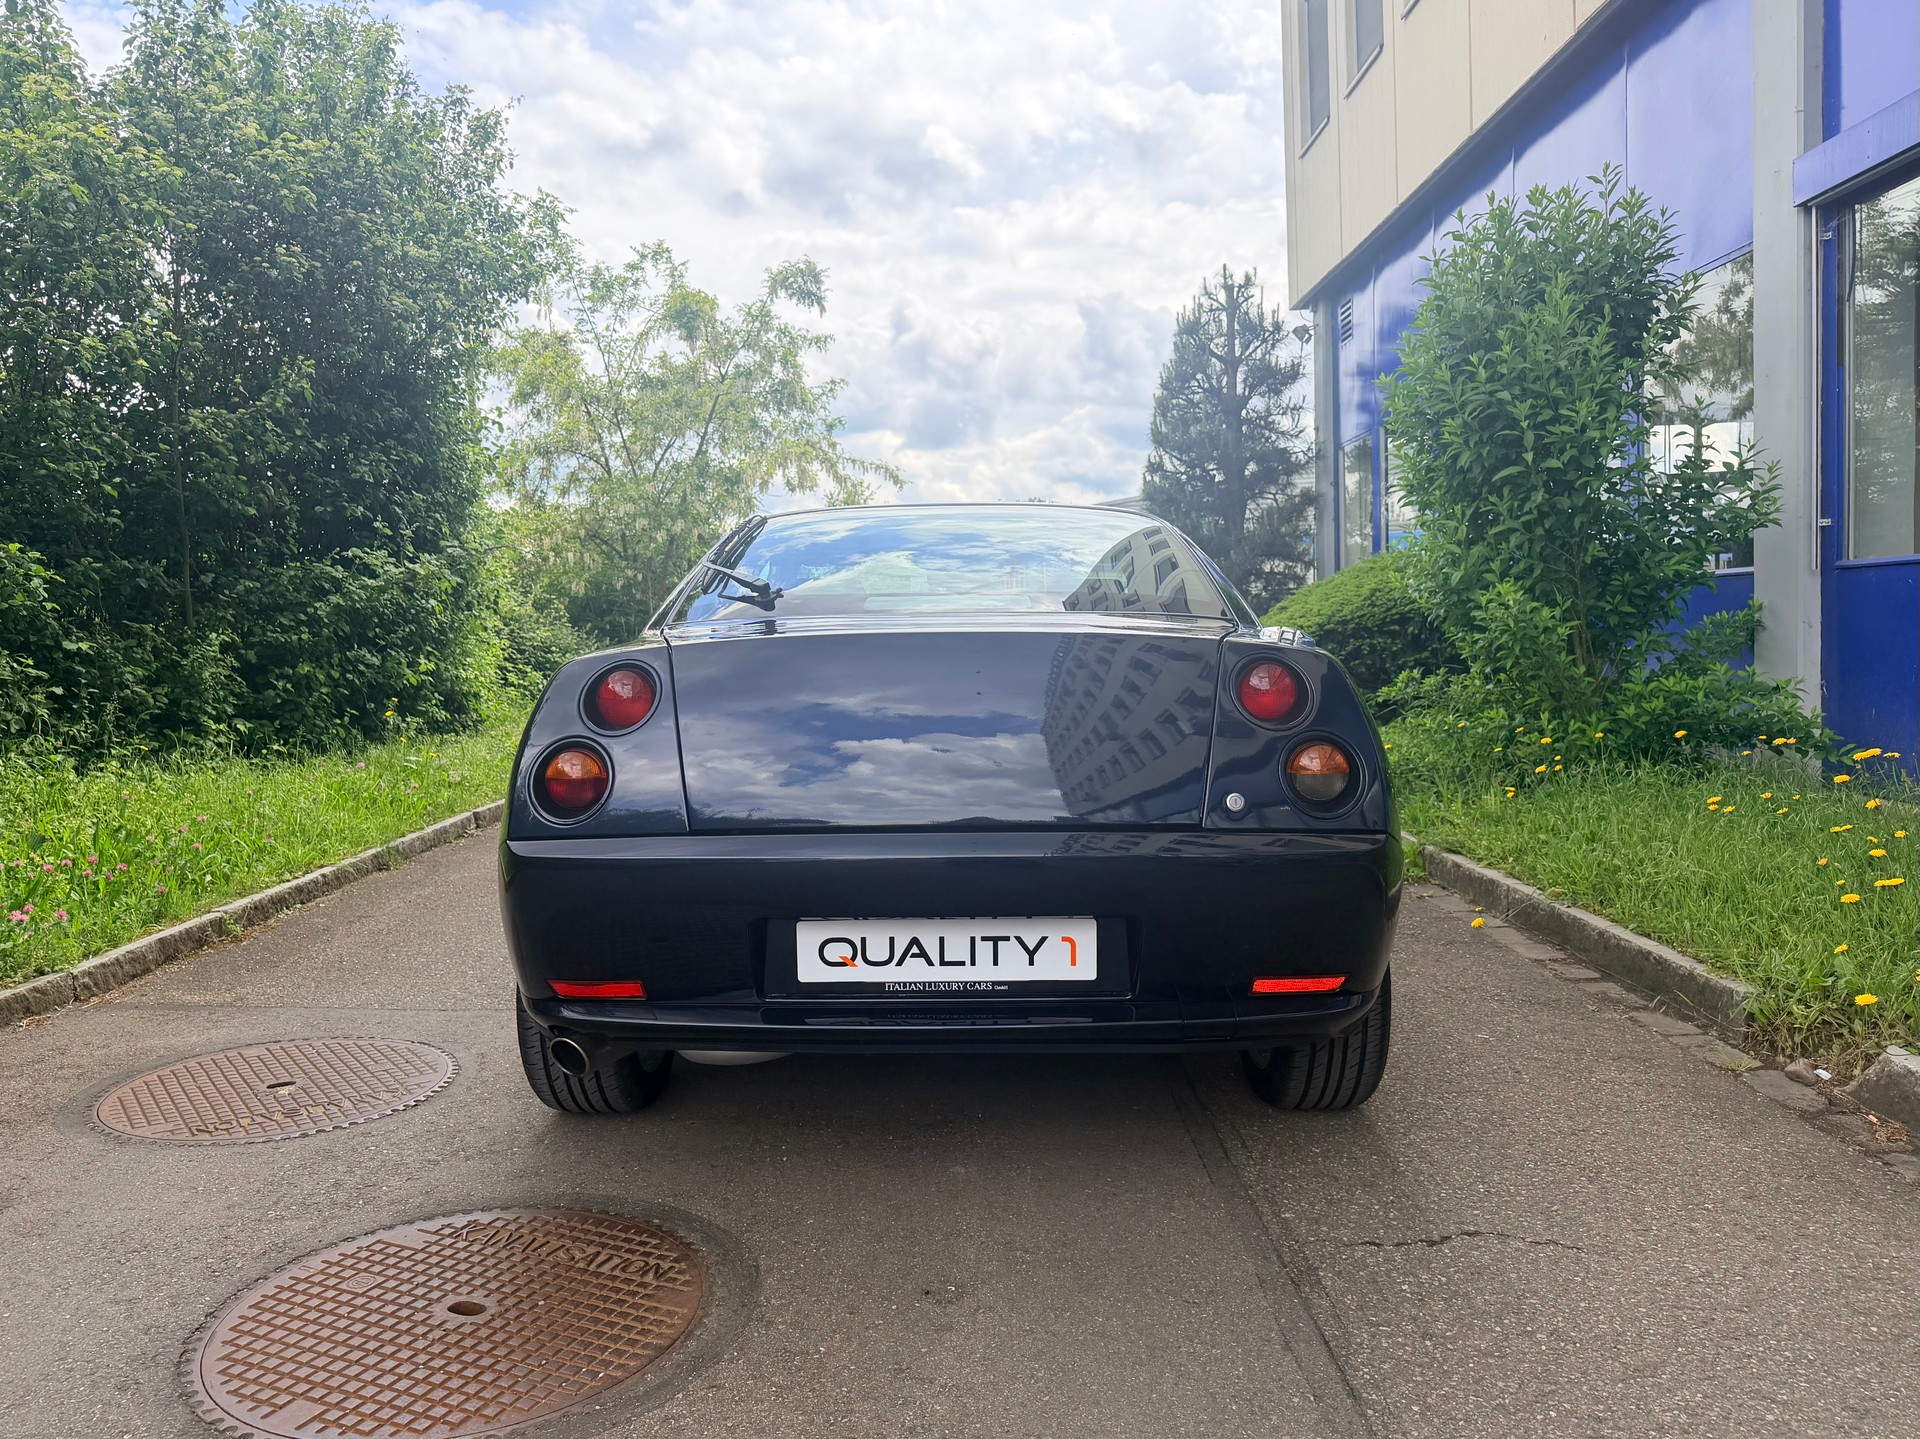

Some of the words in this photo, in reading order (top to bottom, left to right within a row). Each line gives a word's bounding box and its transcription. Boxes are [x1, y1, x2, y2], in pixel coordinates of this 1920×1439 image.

[818, 935, 1049, 968] QUALITY
[1061, 936, 1077, 967] 1
[885, 982, 924, 991] ITALIAN
[925, 982, 965, 991] LUXURY
[966, 982, 993, 991] CARS
[452, 1223, 678, 1281] KANALISATION
